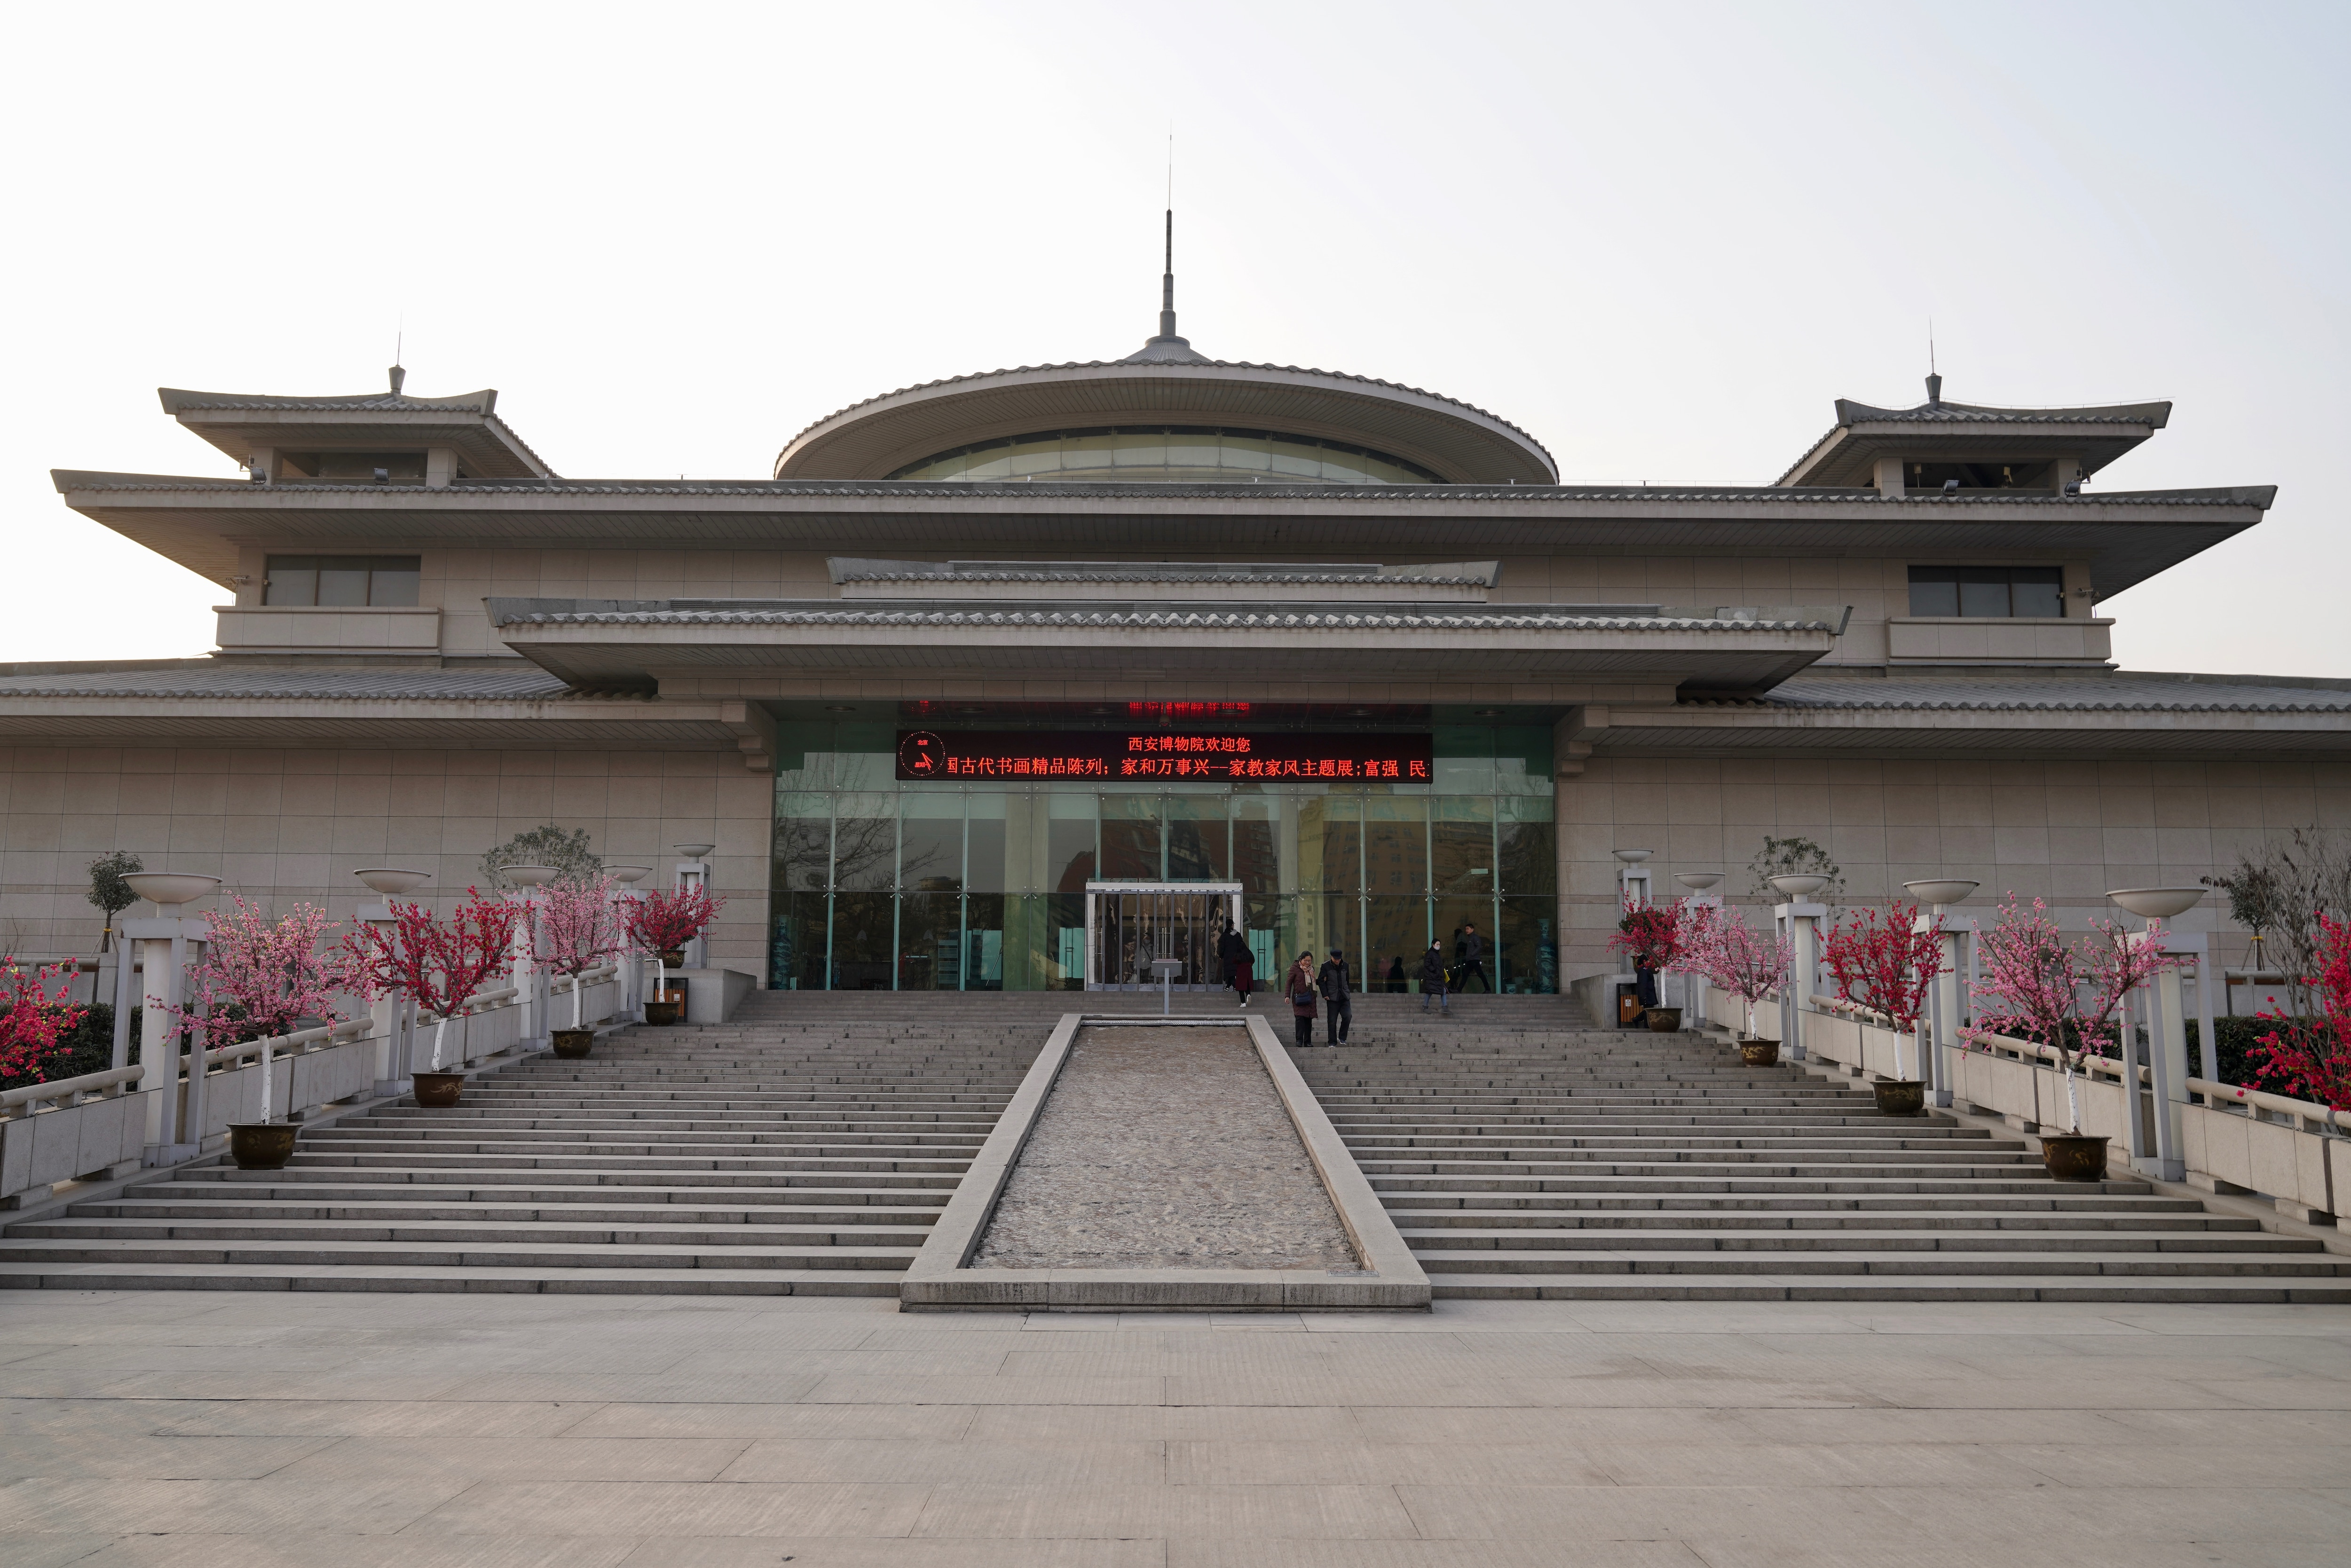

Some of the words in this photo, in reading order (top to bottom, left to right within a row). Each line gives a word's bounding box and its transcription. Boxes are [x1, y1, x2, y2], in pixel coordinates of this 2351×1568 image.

[1128, 736, 1251, 752] 西安博物院欢迎您
